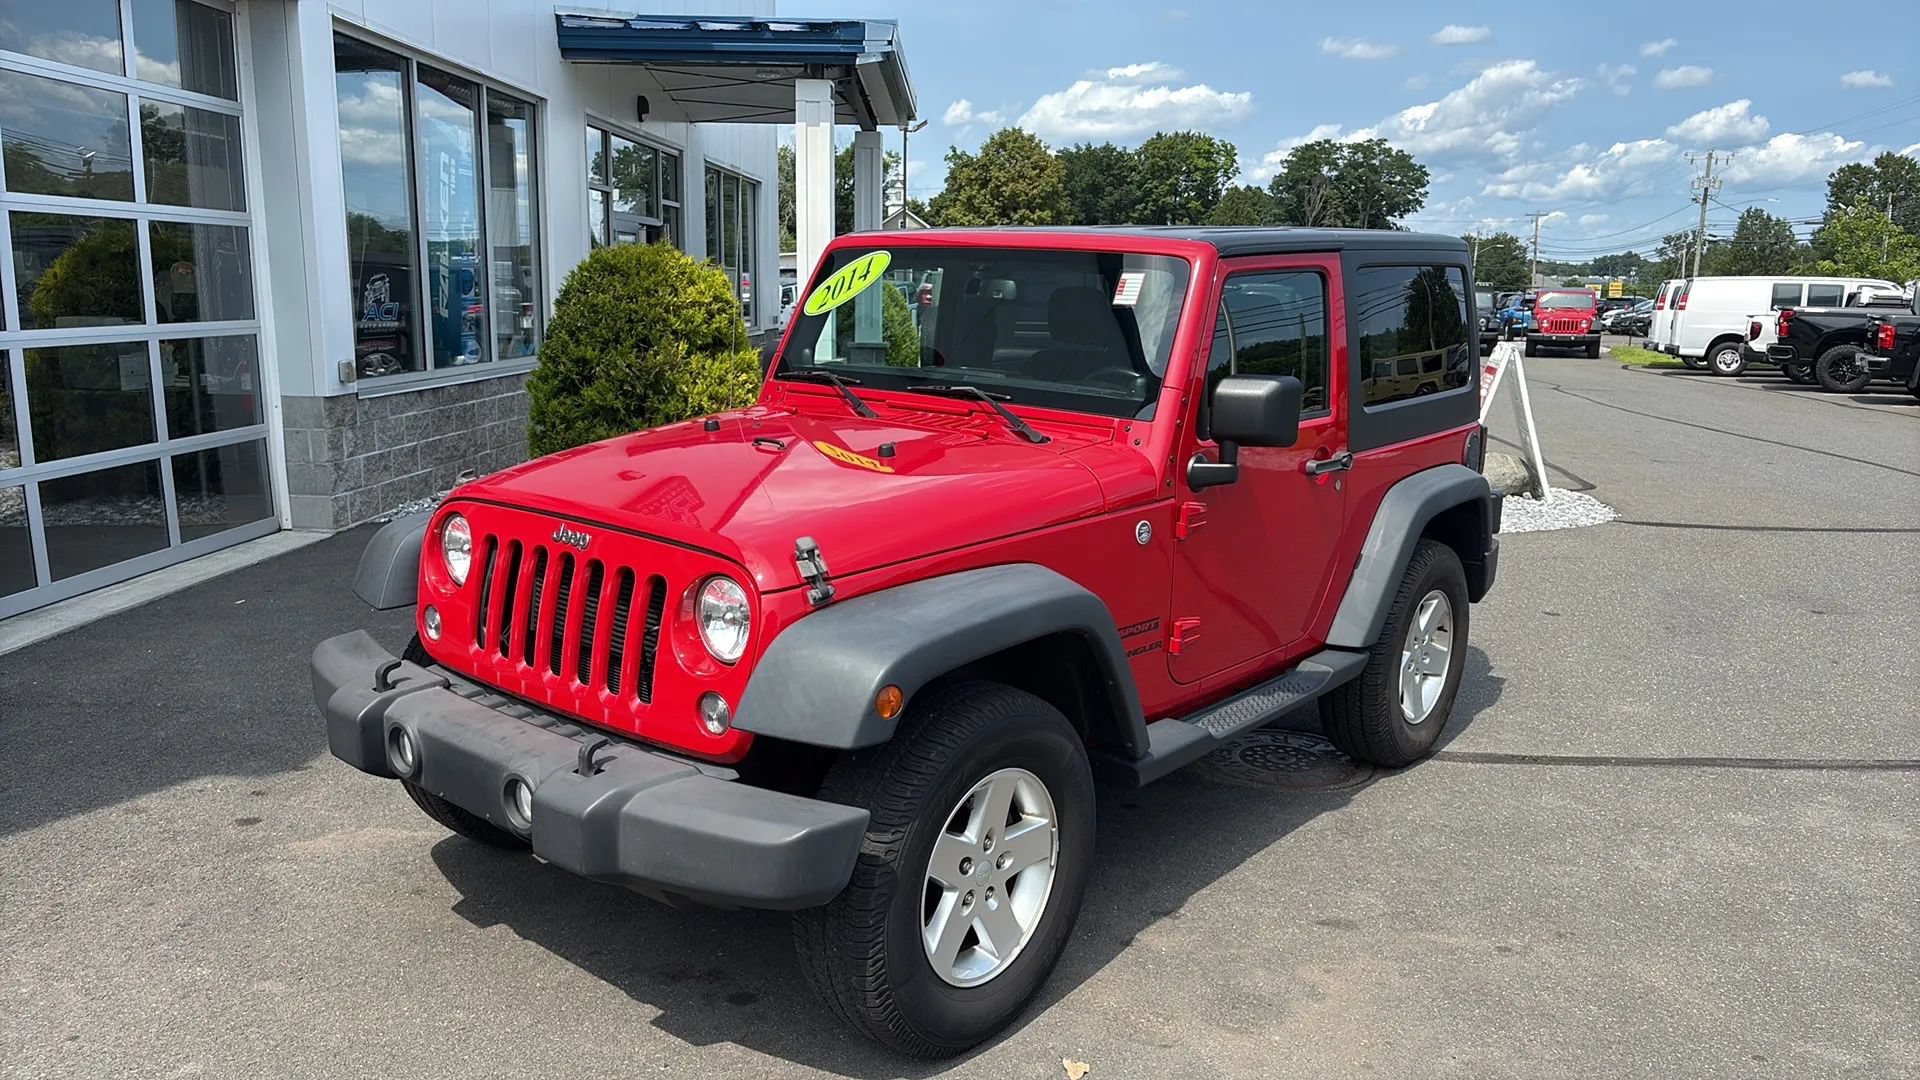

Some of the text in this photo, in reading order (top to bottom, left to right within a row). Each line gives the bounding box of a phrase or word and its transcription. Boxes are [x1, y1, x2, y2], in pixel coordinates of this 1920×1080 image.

[817, 257, 874, 311] 2014
[362, 302, 399, 321] ACI
[553, 523, 592, 551] Jeep
[1119, 620, 1159, 638] SPORT
[1125, 640, 1162, 657] NGLER
